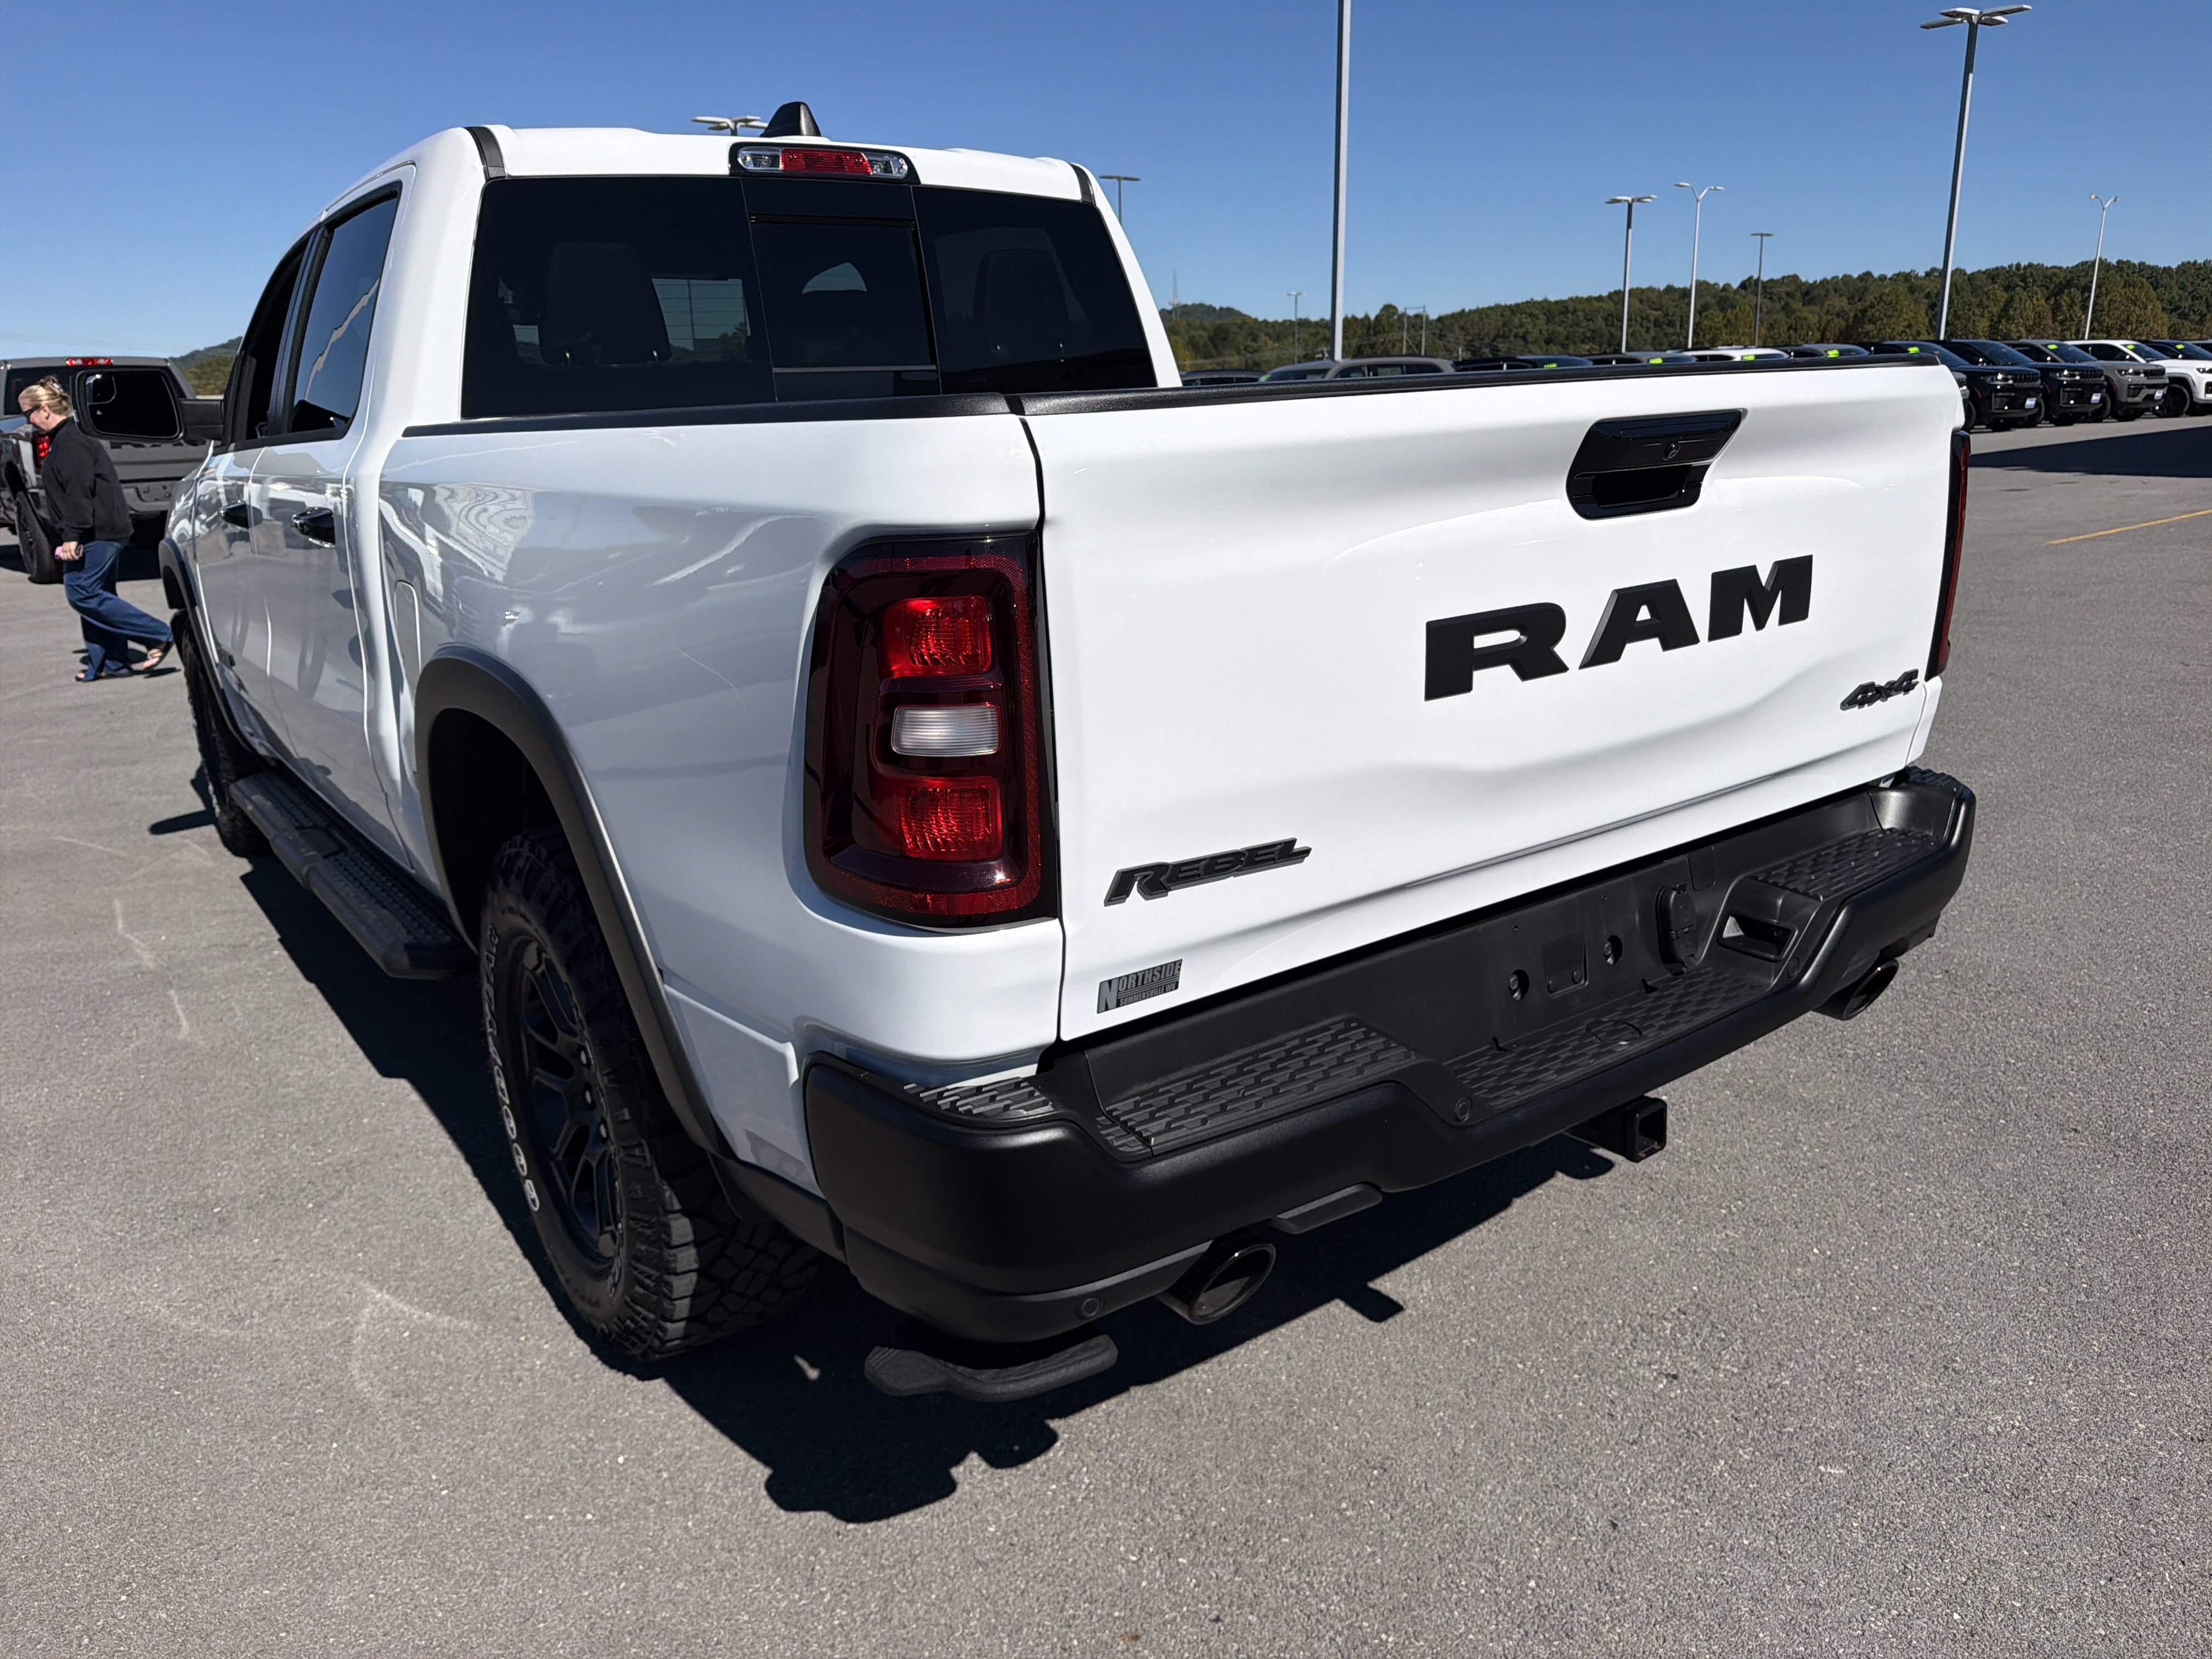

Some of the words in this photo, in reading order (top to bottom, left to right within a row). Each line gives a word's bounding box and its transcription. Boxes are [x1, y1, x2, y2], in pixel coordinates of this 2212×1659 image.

[1424, 554, 1813, 702] RAM
[1104, 837, 1312, 907] REBEL
[1097, 960, 1182, 1013] NORTHSIDE
[1119, 986, 1165, 1007] SUMMERSVILLE
[1165, 982, 1176, 992] WV
[483, 924, 539, 1212] GOODYEAR
